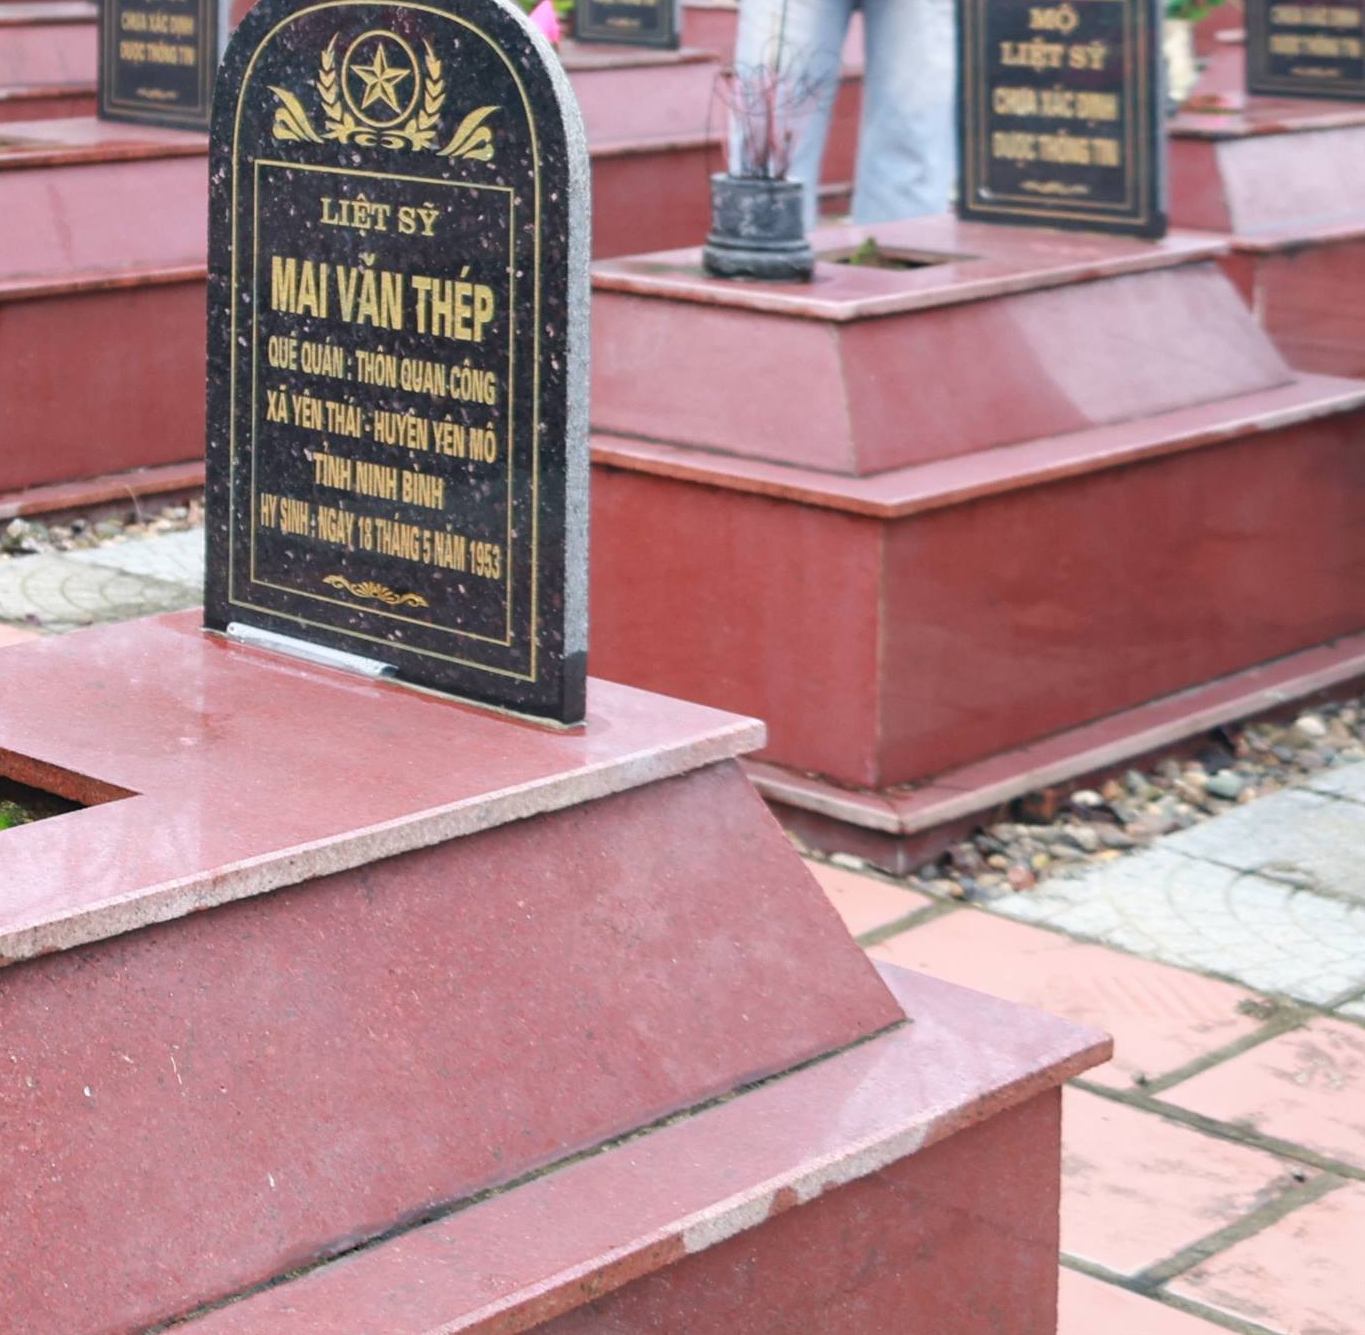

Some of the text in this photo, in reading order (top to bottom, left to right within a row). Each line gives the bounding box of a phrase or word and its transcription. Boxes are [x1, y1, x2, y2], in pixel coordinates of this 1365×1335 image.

[999, 36, 1064, 73] LIỆT
[1029, 4, 1078, 35] MỘ
[320, 192, 440, 237] LIỆT SỸ
[271, 252, 495, 343] MAI VĂN THÉP
[268, 330, 298, 370] QUÊ
[301, 336, 344, 379] QUÁN
[355, 345, 397, 388] THÔN
[400, 357, 446, 397] QUAN
[449, 358, 497, 405] CÔNG
[267, 384, 288, 424] XÃ
[292, 388, 322, 431] YÊN
[325, 396, 362, 438] THÁI
[374, 407, 428, 458] HUYỆN
[432, 414, 465, 458] YÊN
[469, 421, 497, 464] MÔ
[312, 441, 445, 510] TỈNH NINH BÌNH
[260, 493, 277, 528] HY
[280, 497, 310, 535] SINH
[318, 500, 355, 548] NGÀY
[358, 516, 373, 551] 18
[375, 512, 419, 562] THÁNG
[422, 526, 431, 564] 5
[434, 523, 466, 572] NĂM
[470, 539, 501, 580] 1953
